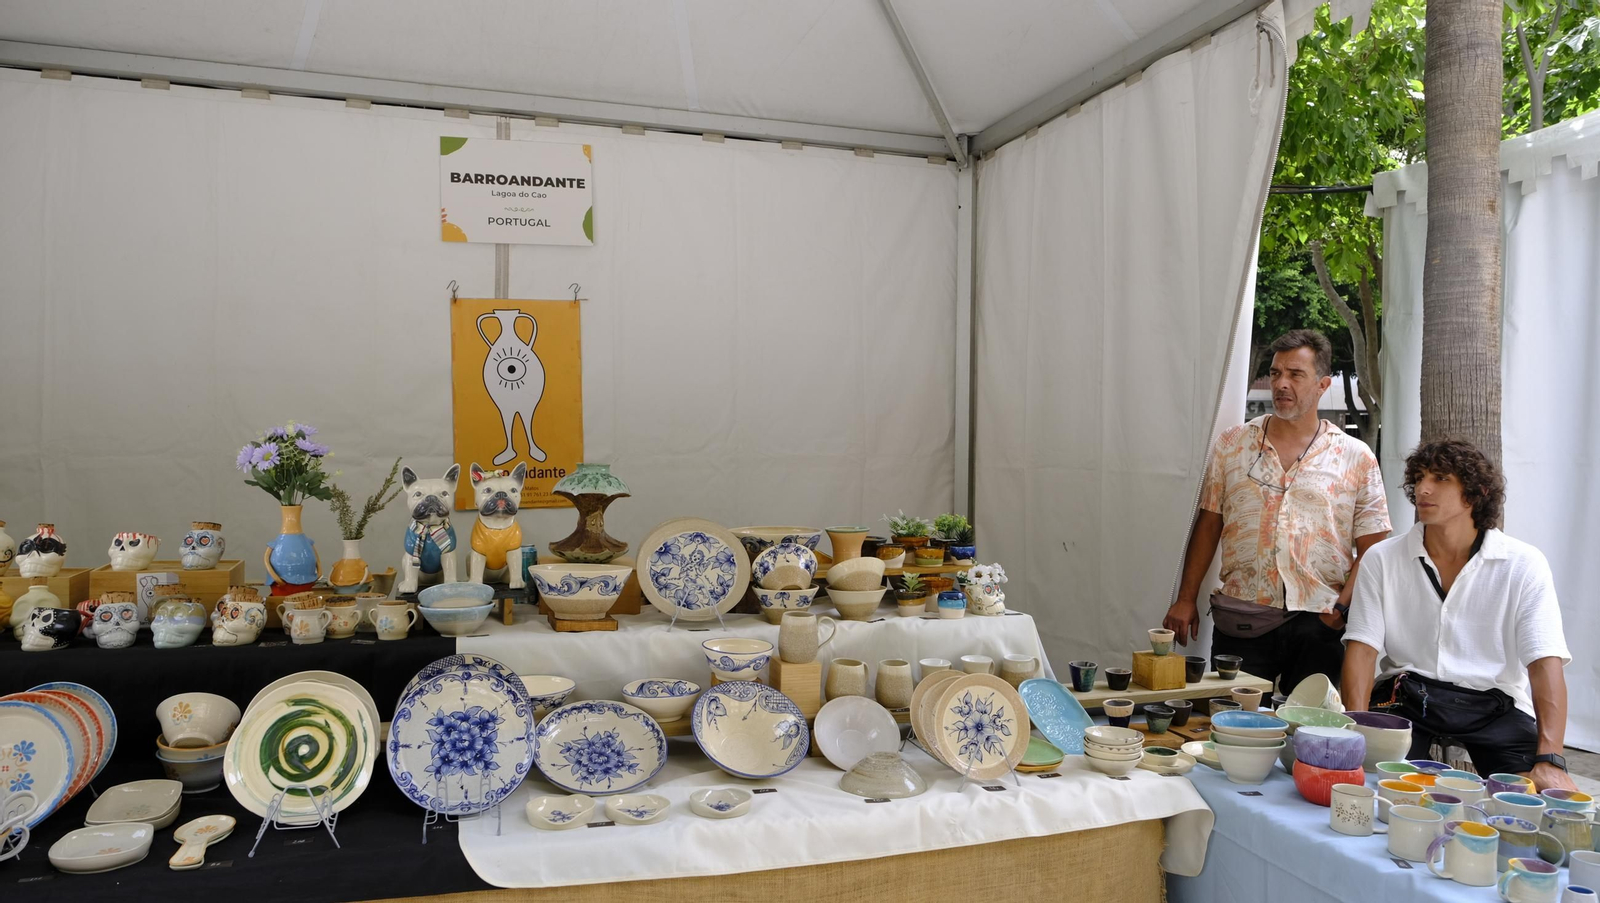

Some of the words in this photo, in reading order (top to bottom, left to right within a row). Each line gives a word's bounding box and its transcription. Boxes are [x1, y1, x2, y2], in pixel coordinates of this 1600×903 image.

[450, 172, 586, 189] BARROANDANTE
[491, 190, 517, 198] Lagoa
[488, 217, 551, 227] PORTUGAL
